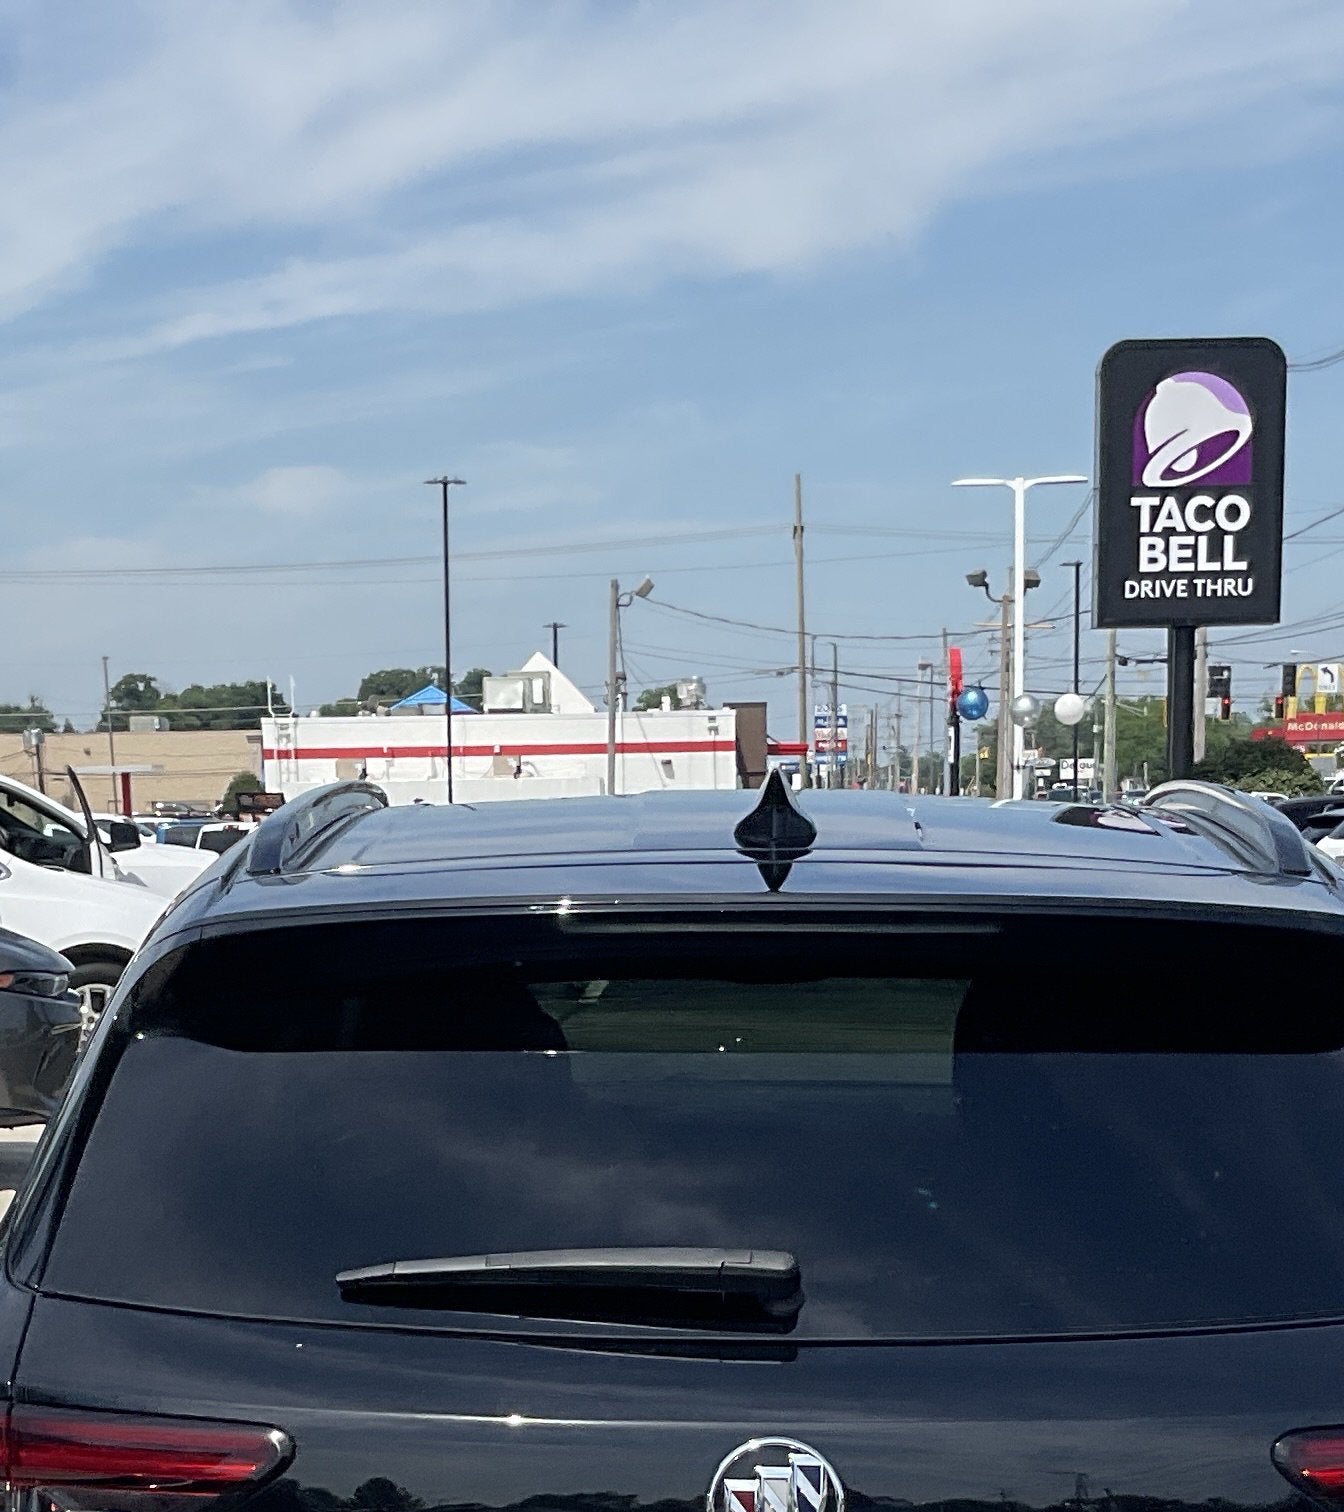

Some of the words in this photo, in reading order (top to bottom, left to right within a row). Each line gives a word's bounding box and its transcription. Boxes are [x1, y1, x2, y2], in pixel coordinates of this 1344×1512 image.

[1130, 494, 1252, 533] TACO
[1138, 534, 1248, 573] BELL
[1124, 579, 1188, 599] DRIVE
[1193, 577, 1254, 598] THRU
